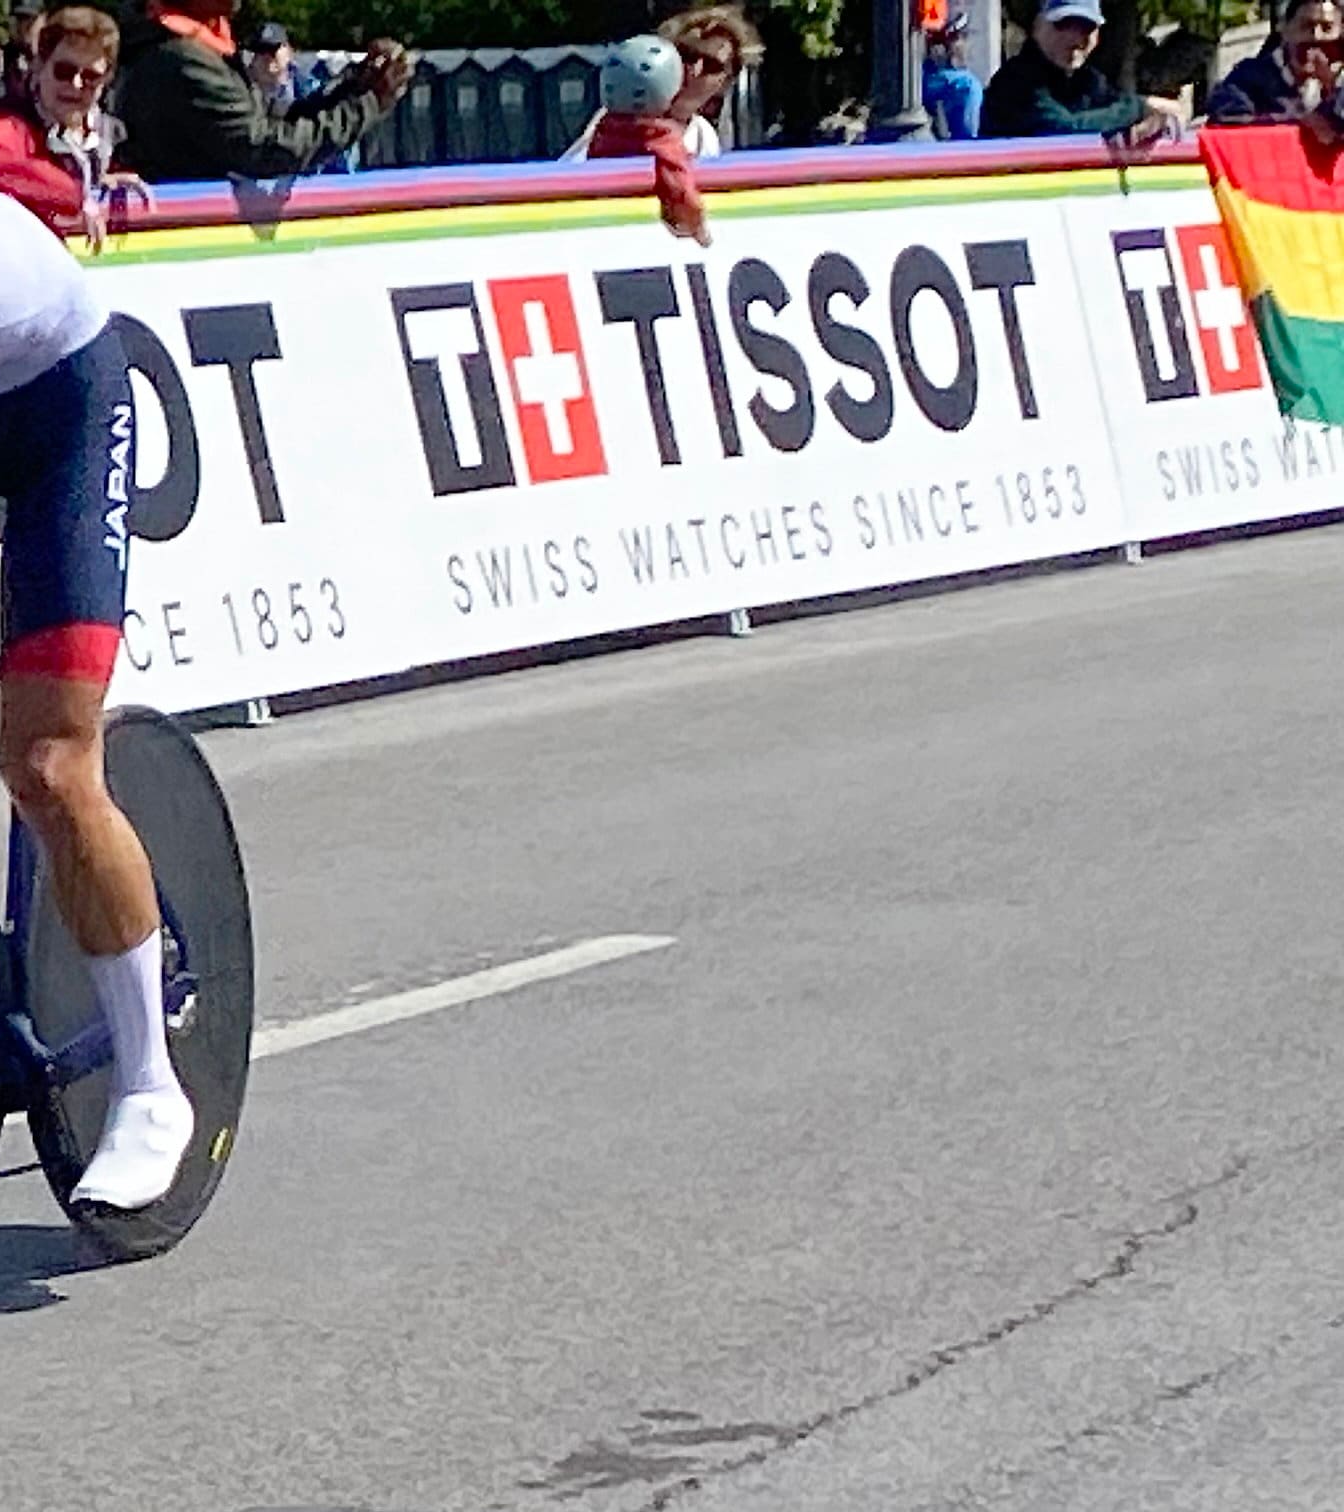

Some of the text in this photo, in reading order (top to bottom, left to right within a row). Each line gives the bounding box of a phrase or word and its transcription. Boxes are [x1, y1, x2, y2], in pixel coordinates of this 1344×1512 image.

[594, 239, 1039, 466] TISSOT
[103, 404, 133, 572] JAPAN
[446, 464, 1087, 615] SWISS WATCHES SINCE 1853
[1156, 437, 1261, 501] SWISS
[222, 577, 346, 656] 1853
